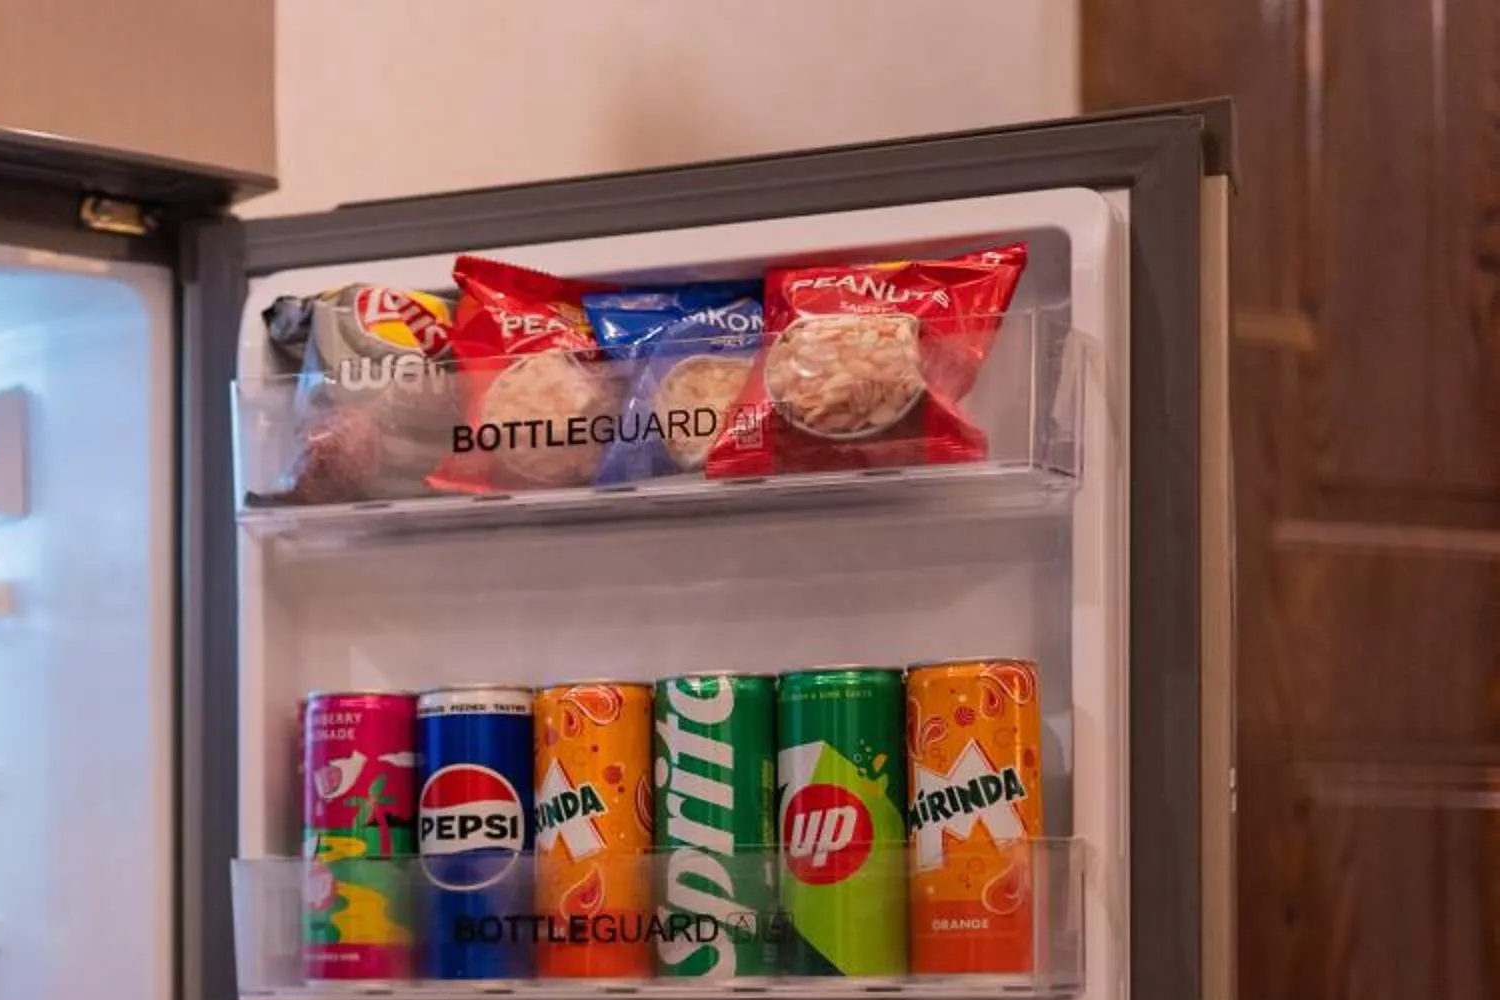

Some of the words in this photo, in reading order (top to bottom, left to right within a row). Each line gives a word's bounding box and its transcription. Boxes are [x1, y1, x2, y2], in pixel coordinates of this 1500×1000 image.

[452, 408, 717, 453] BOTTLEGUARD
[421, 814, 519, 841] PEPSI
[454, 914, 719, 943] BOTTLEGUARD
[932, 918, 989, 931] ORANGE
